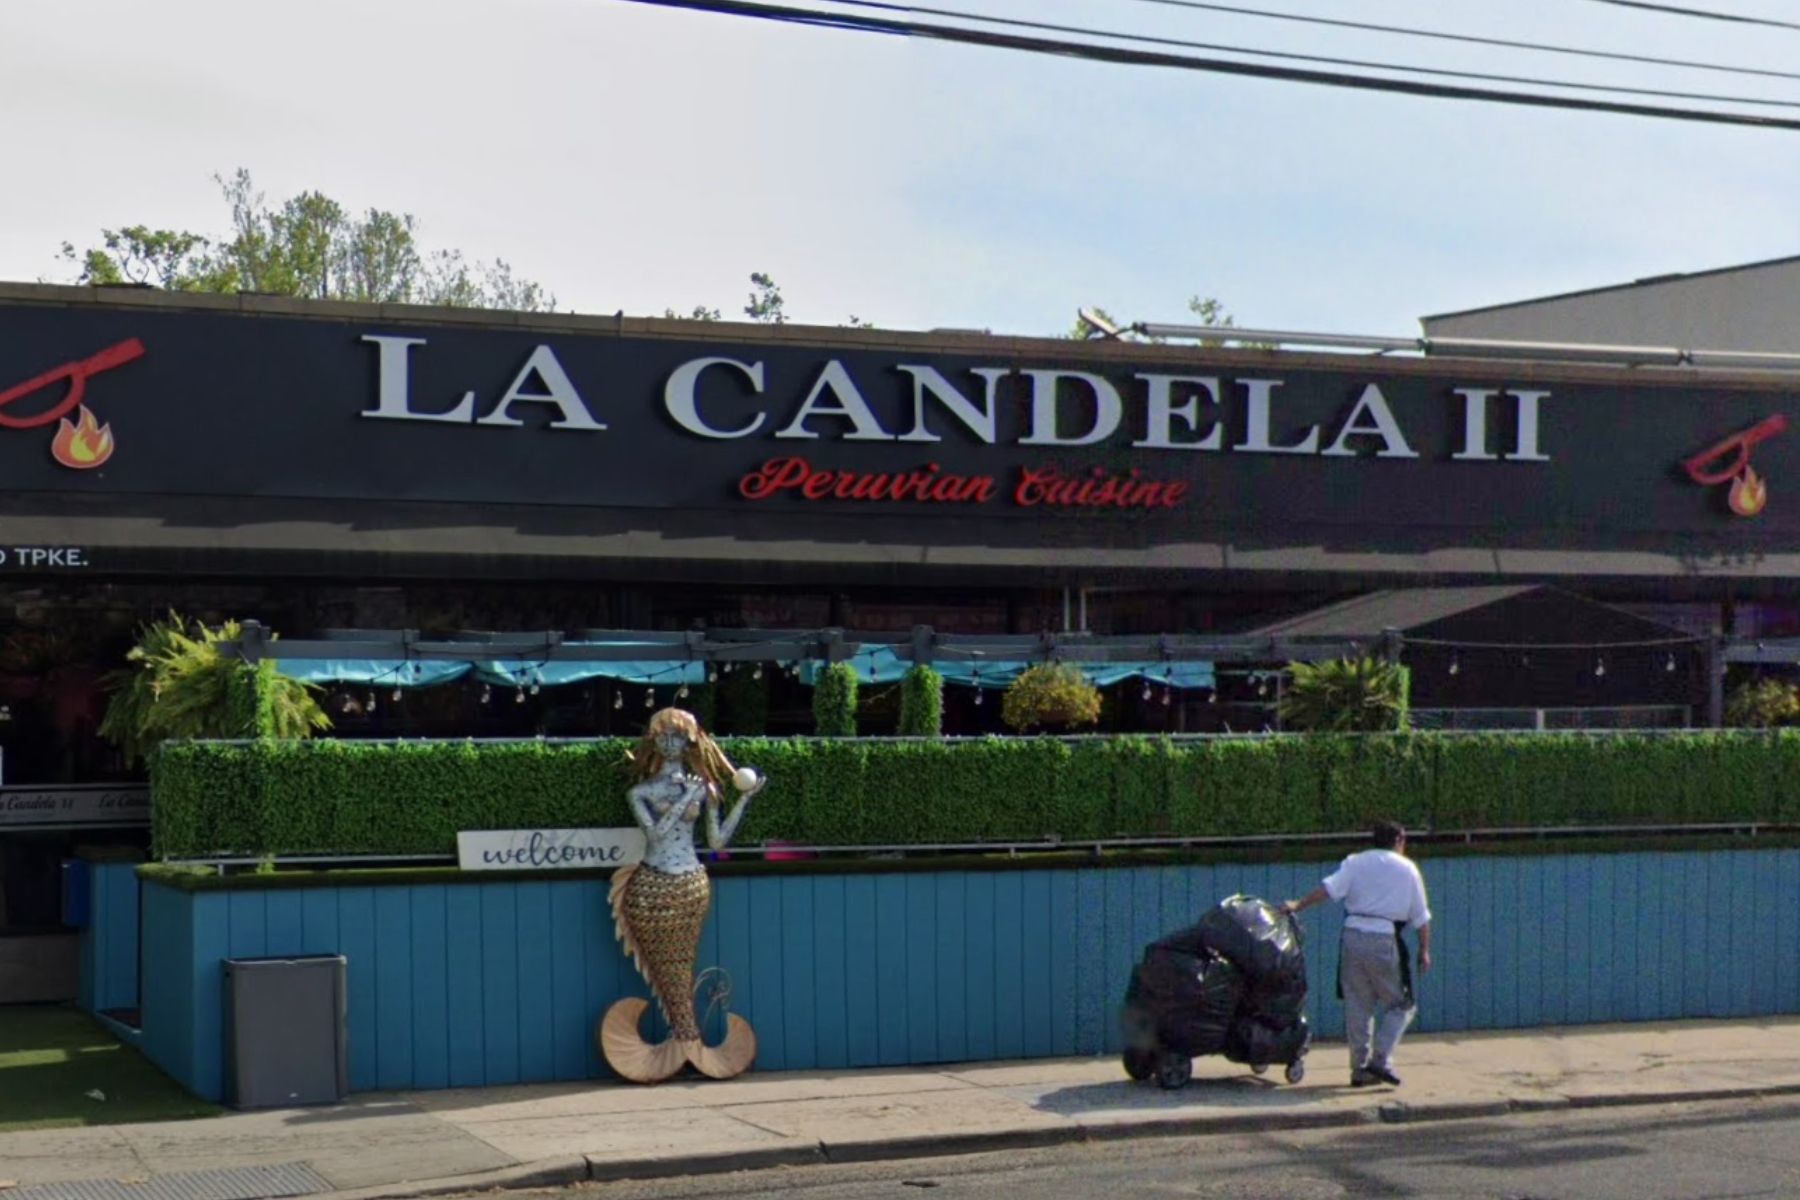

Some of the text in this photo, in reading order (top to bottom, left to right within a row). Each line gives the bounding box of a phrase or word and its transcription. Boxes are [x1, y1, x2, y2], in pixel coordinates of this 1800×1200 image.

[360, 335, 1551, 462] LA CANDELA II
[738, 456, 1187, 507] Peruvian Cuisine
[13, 547, 89, 567] TPKE.
[483, 831, 626, 867] welcome
